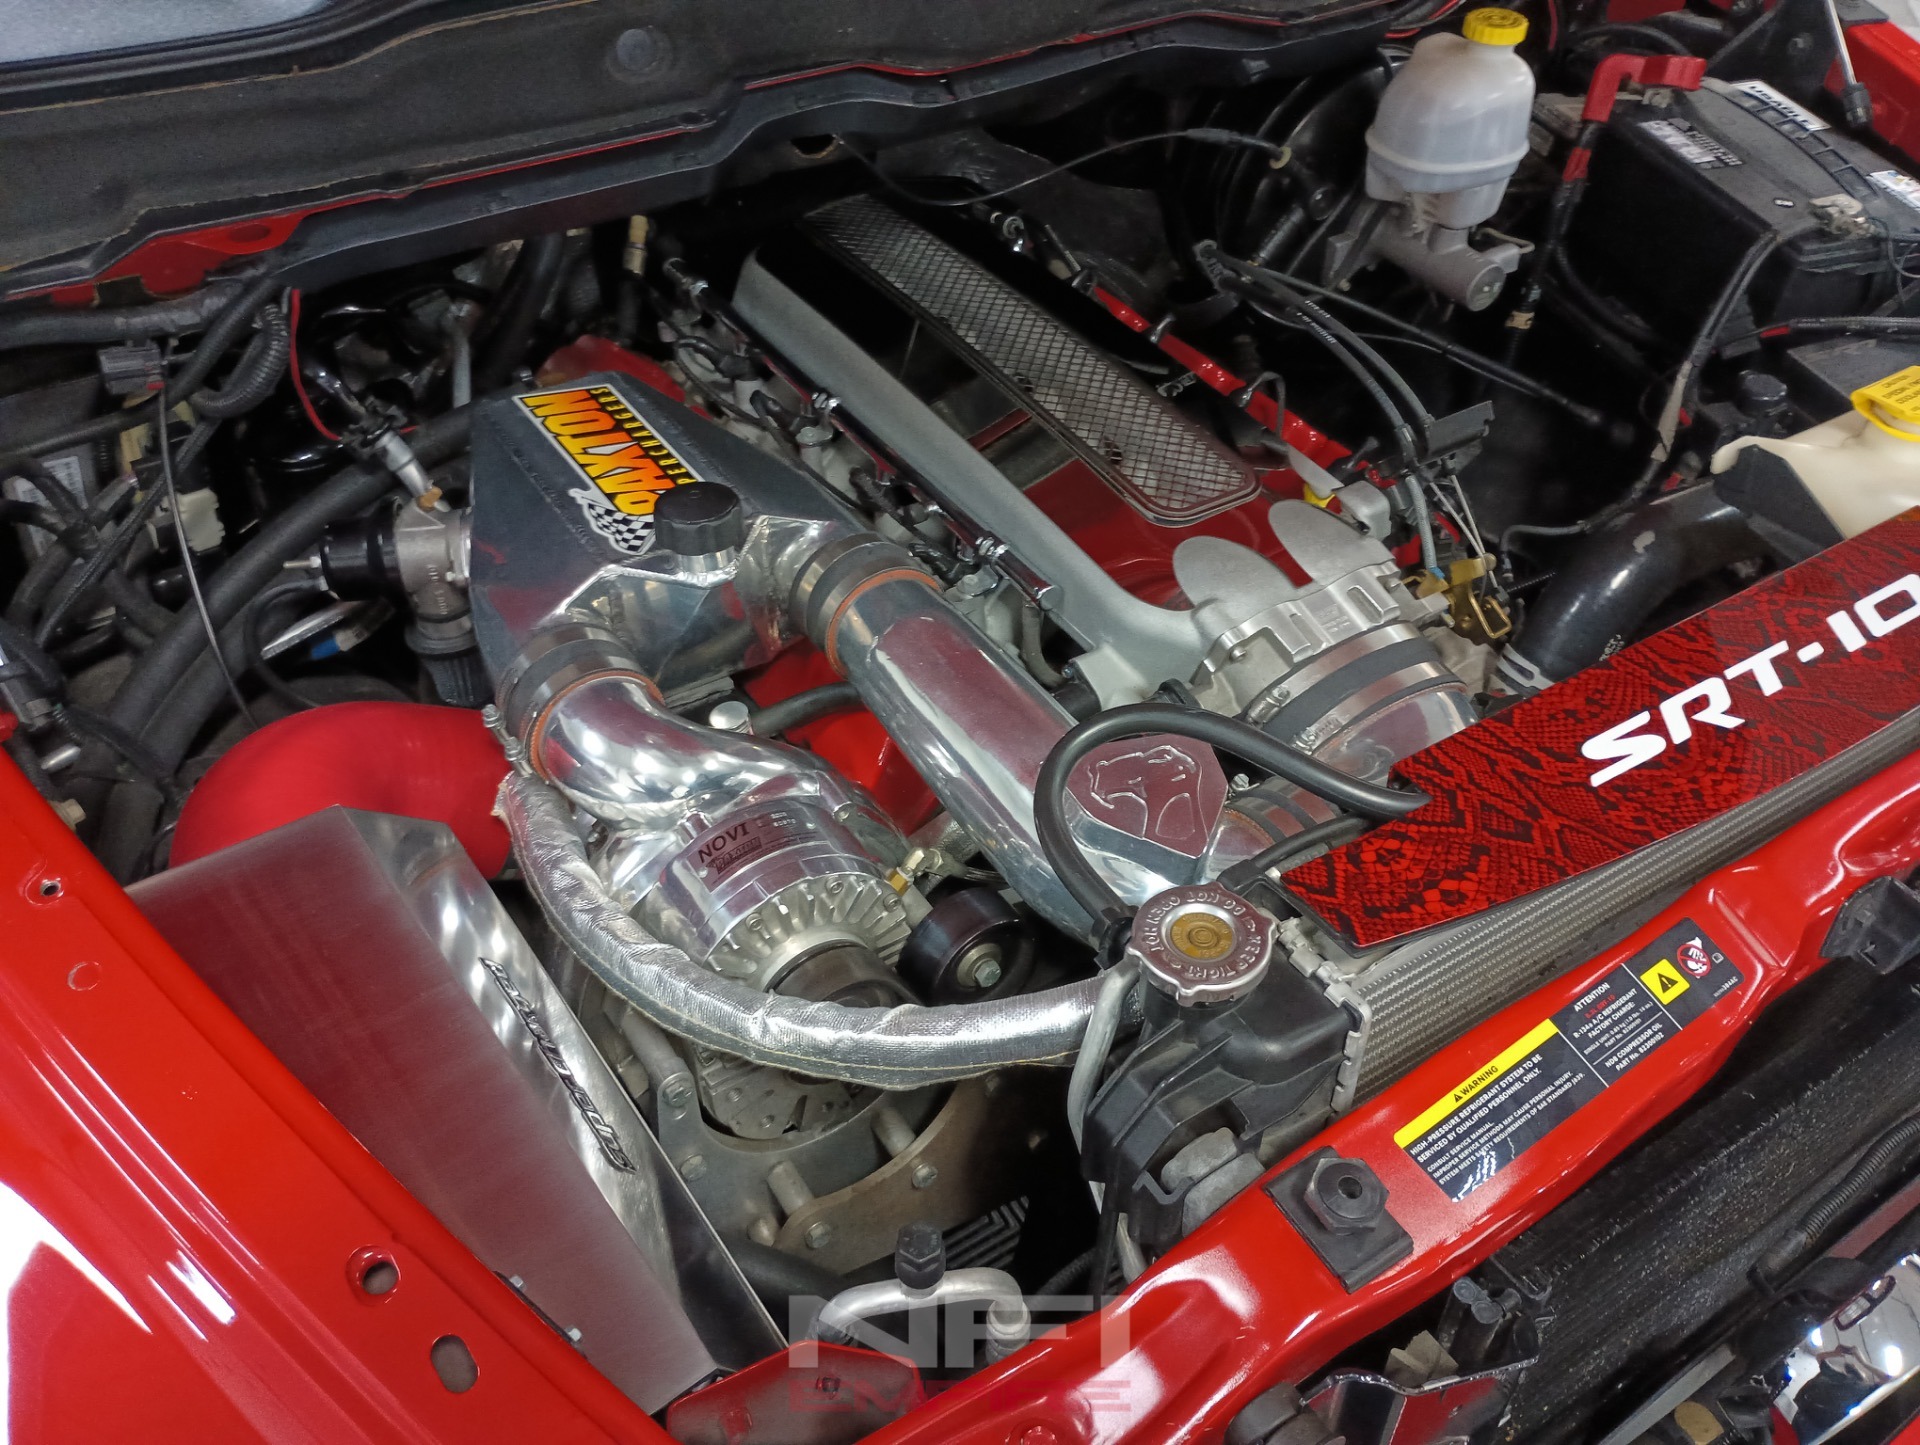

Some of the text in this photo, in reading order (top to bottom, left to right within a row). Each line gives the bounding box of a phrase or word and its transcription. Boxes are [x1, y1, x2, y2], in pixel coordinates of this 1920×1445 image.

[590, 386, 698, 485] PERCHARGERS
[1581, 573, 1920, 787] SRT-10
[697, 822, 750, 864] NOVI
[1186, 891, 1220, 902] NOT
[1572, 982, 1610, 1012] ATTENTION
[1573, 988, 1637, 1038] R-134a A/C REFRIGERANT
[1587, 1001, 1635, 1038] FACTORY CHARGE:
[1604, 1037, 1616, 1047] PART
[1615, 1058, 1630, 1071] PART
[1629, 1050, 1640, 1060] No.
[1616, 1029, 1653, 1058] COMPRESSOR
[1651, 1022, 1662, 1031] OIL
[1460, 1065, 1499, 1096] WARNING
[1410, 1054, 1542, 1155] HIGH-PRESSURE REFRIGERANT SYSTEM TO BE
[1417, 1067, 1541, 1163] SERVICED BY QUALIFIED PERSONNEL ONLY.
[1433, 1070, 1573, 1178] IMPROPER SERVICE METHODS MAY CAUSE PERSONAL INJURY.
[1427, 1120, 1494, 1172] CONSULT SERVICE MANUAL.
[1439, 1168, 1459, 1184] SYSTEM
[1458, 1155, 1476, 1169] MEETS
[1474, 1141, 1494, 1157] SAFETY
[1492, 1113, 1531, 1143] REQUIREMENTS
[1546, 1082, 1572, 1102] STANDARD
